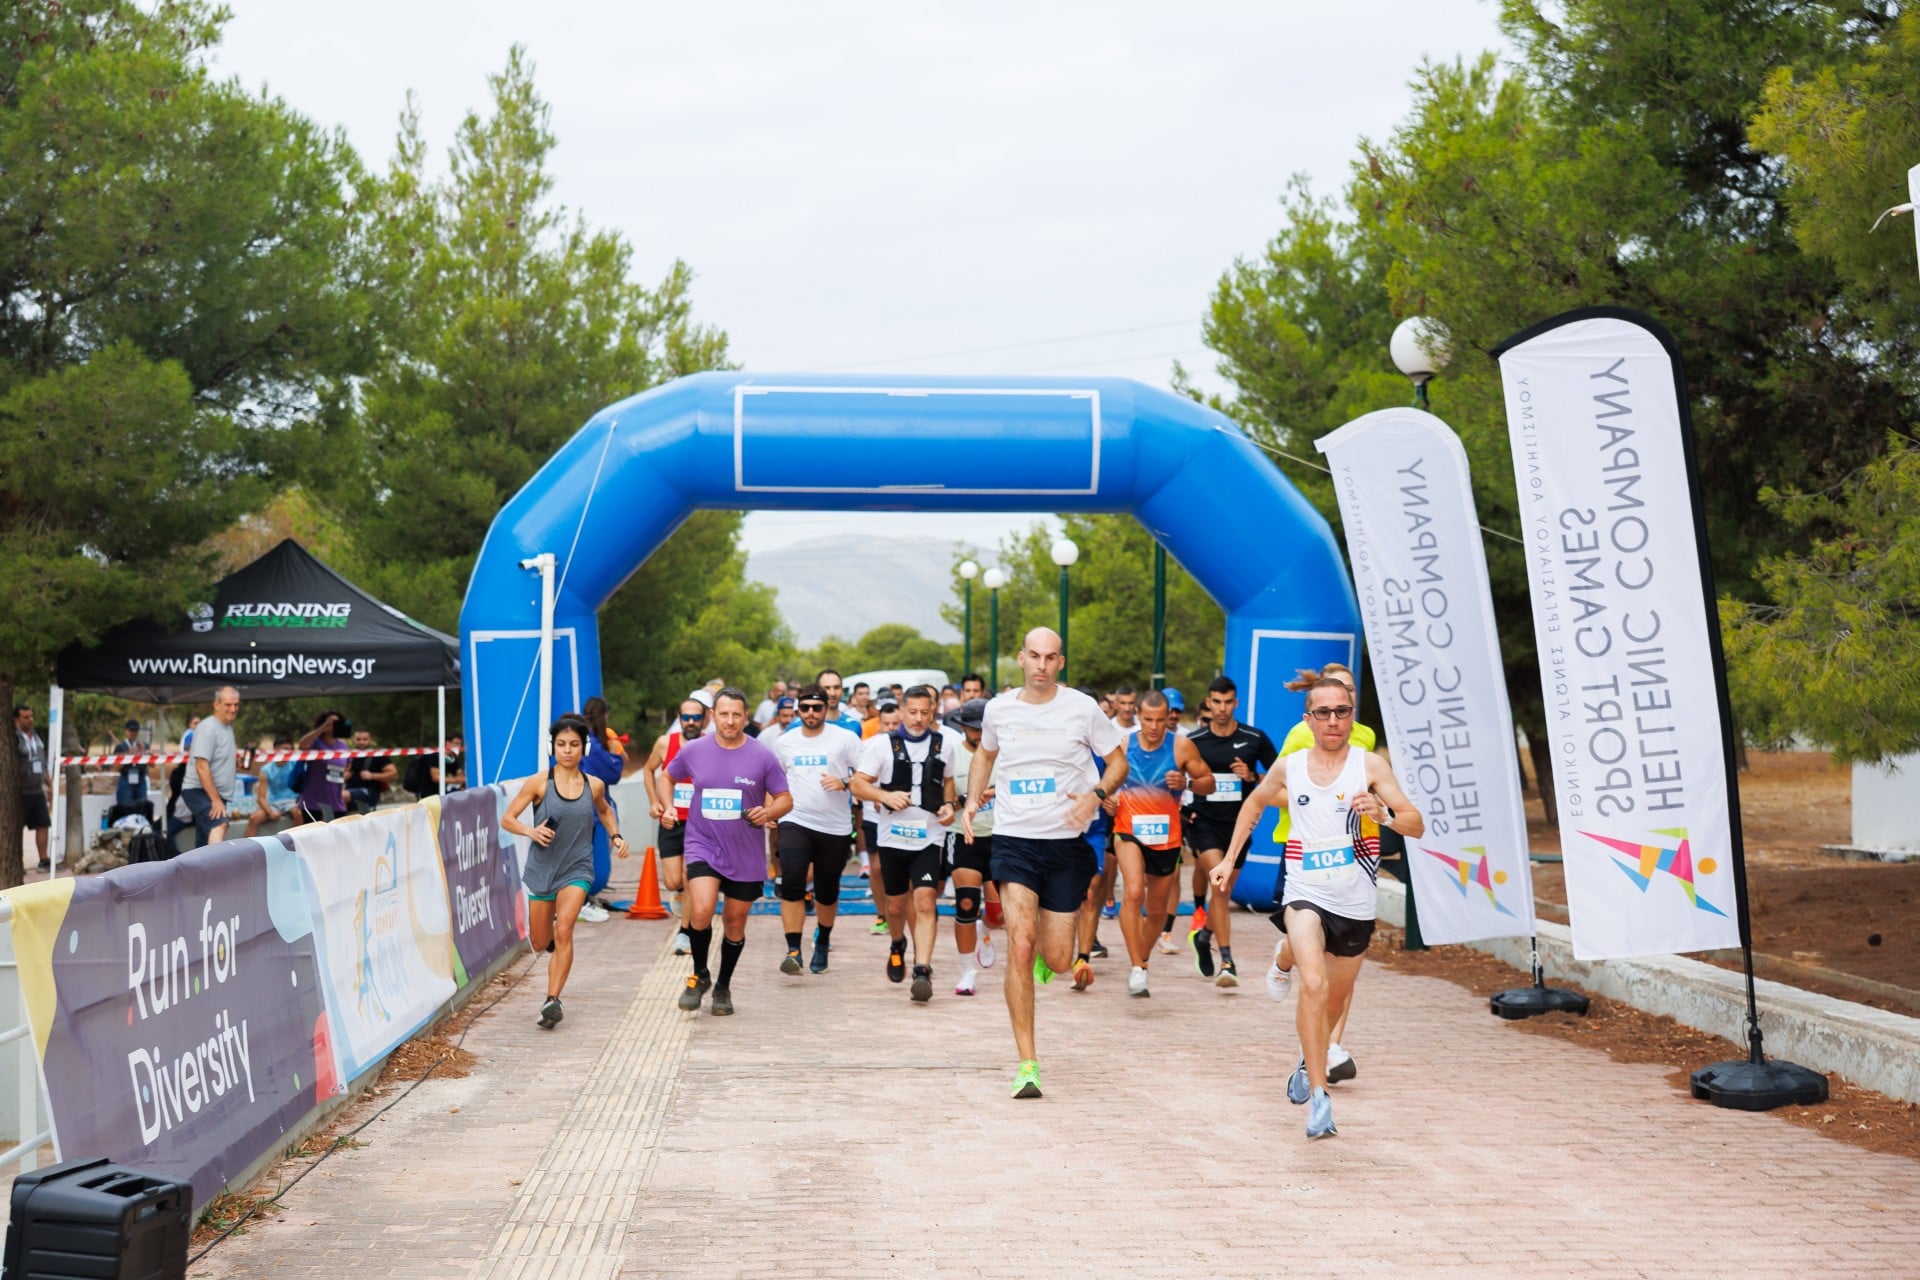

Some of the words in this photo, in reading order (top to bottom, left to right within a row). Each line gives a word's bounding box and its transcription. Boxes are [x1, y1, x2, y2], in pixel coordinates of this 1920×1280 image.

[227, 603, 351, 617] RUNNING
[219, 616, 349, 629] NEWS.GR
[129, 654, 376, 679] www.RunningNews.gr
[1018, 780, 1046, 793] 147
[710, 799, 734, 809] 110
[1140, 824, 1163, 834] 214
[455, 821, 475, 872] Run
[1310, 850, 1346, 868] 104
[456, 876, 494, 934] Diversity
[128, 922, 190, 1020] Run
[199, 898, 240, 990] for
[127, 1009, 256, 1146] Diversity
